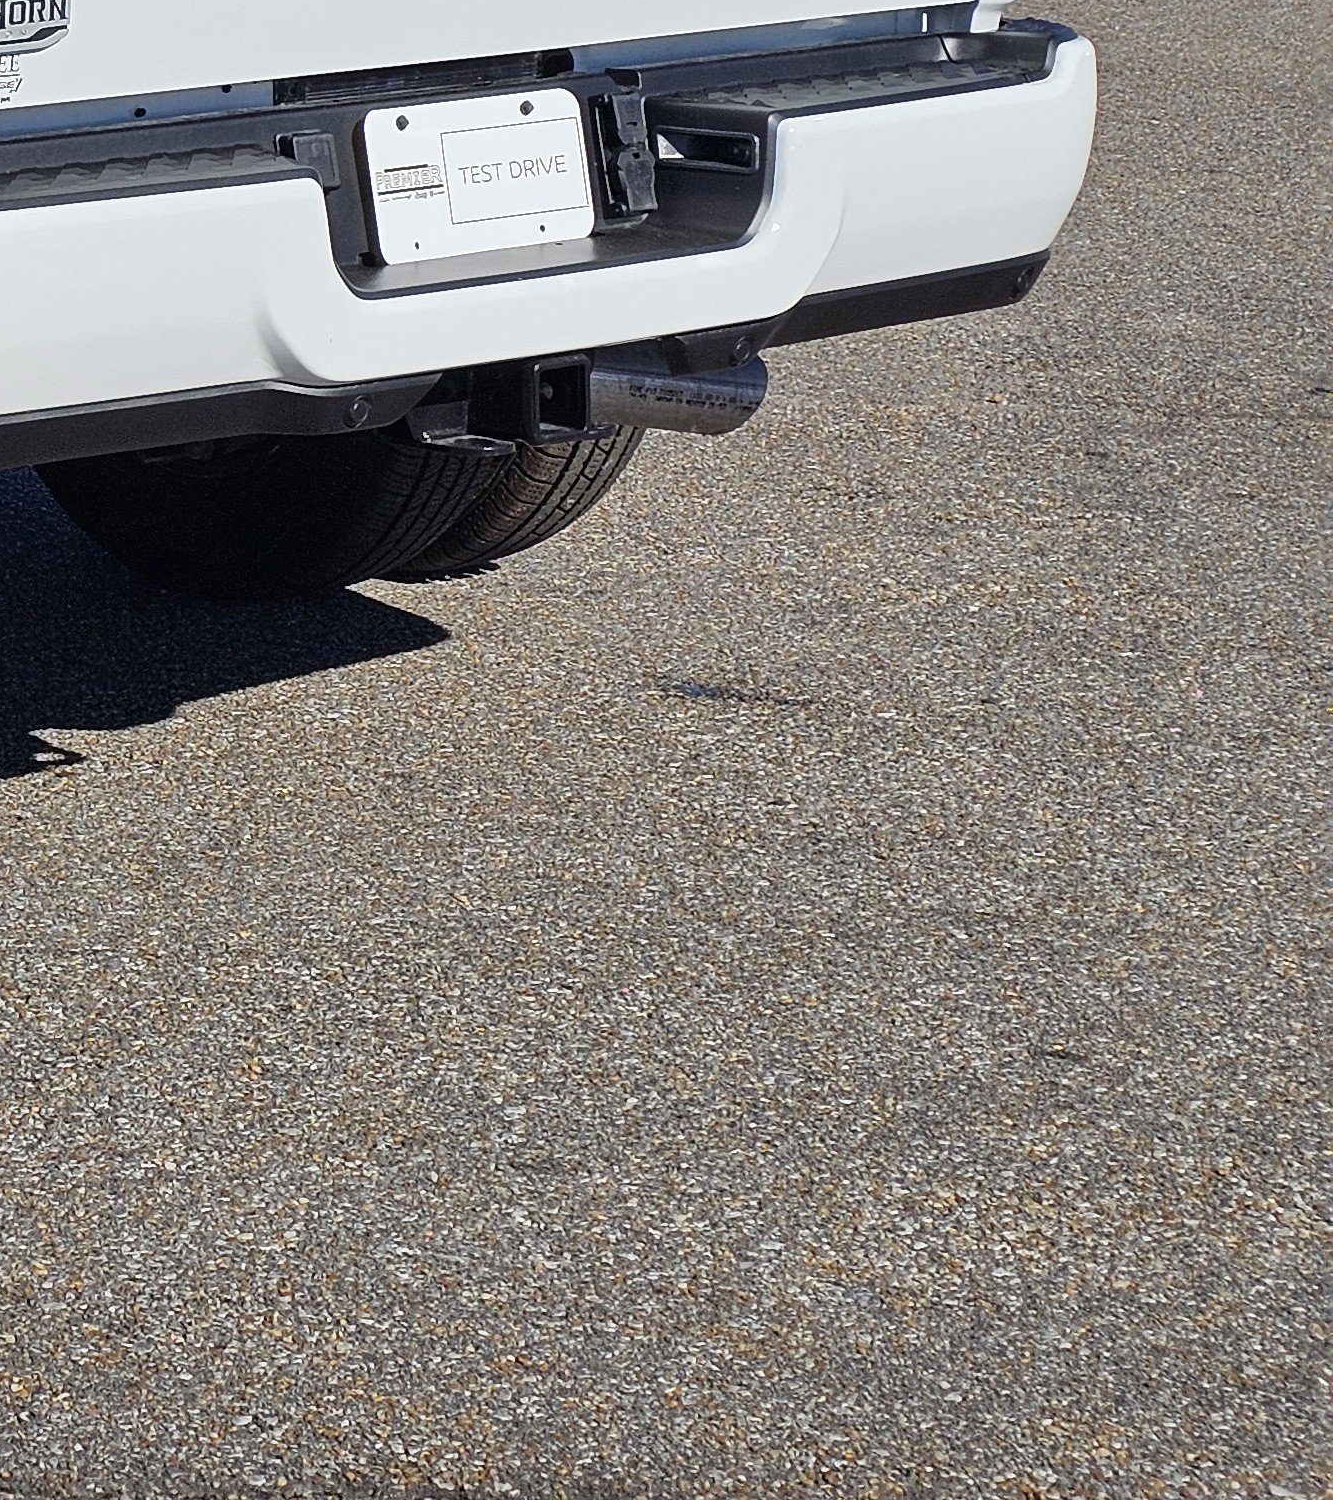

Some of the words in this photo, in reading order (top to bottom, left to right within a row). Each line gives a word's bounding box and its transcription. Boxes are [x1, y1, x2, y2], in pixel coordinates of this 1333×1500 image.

[375, 165, 443, 190] PREMIER
[458, 162, 503, 185] TEST
[509, 155, 567, 179] DRIVE
